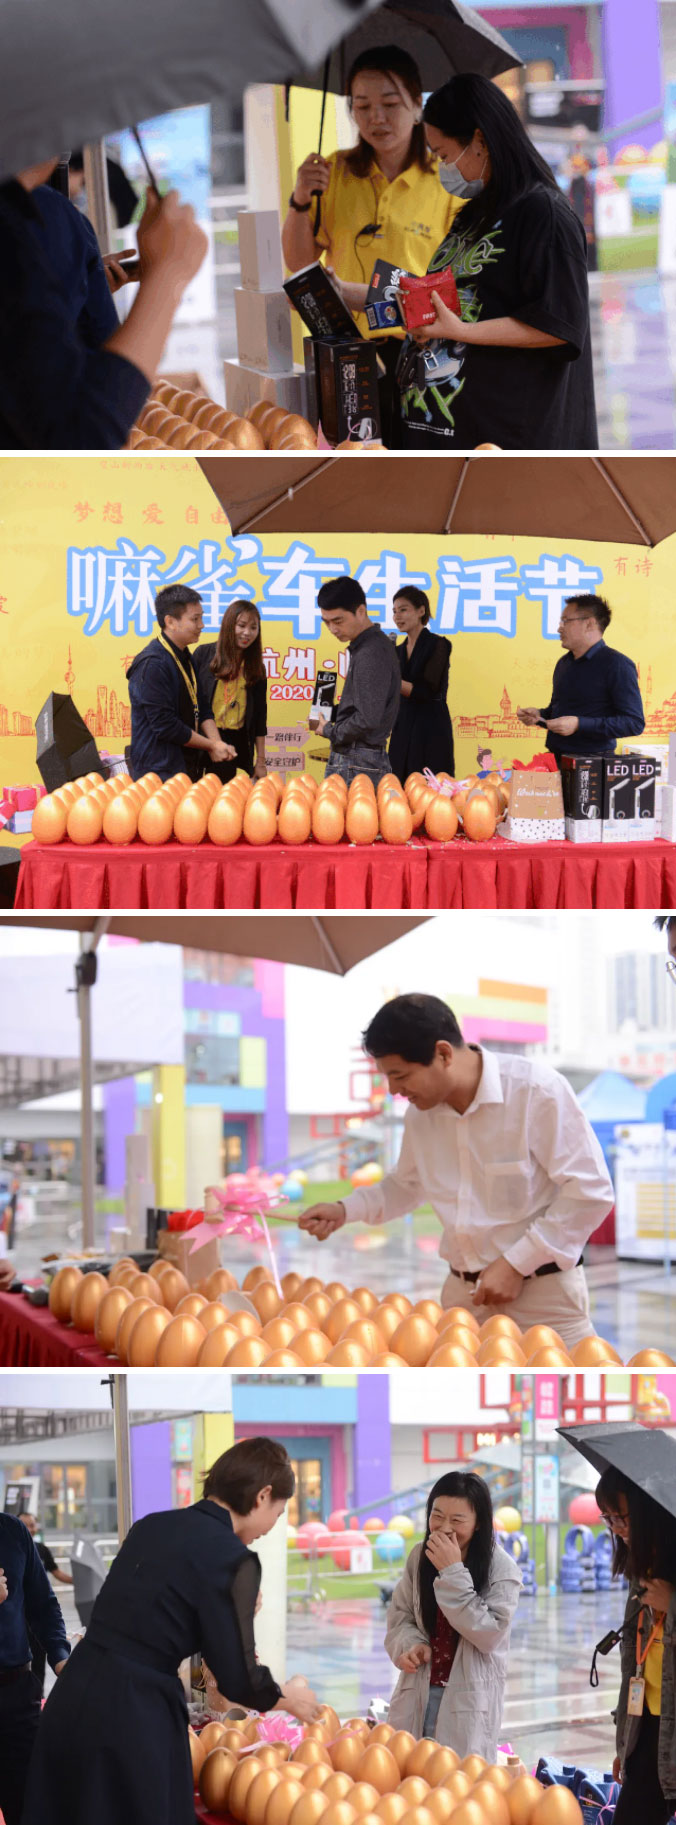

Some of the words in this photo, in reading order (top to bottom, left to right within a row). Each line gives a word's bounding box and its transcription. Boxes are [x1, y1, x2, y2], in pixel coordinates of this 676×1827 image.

[73, 501, 124, 525] 梦想
[142, 503, 165, 525] 爱
[185, 505, 230, 525] 自由
[613, 556, 654, 578] 有诗
[317, 673, 336, 682] LED
[270, 684, 315, 700] 2020
[606, 765, 629, 777] LED
[632, 764, 654, 776] LED
